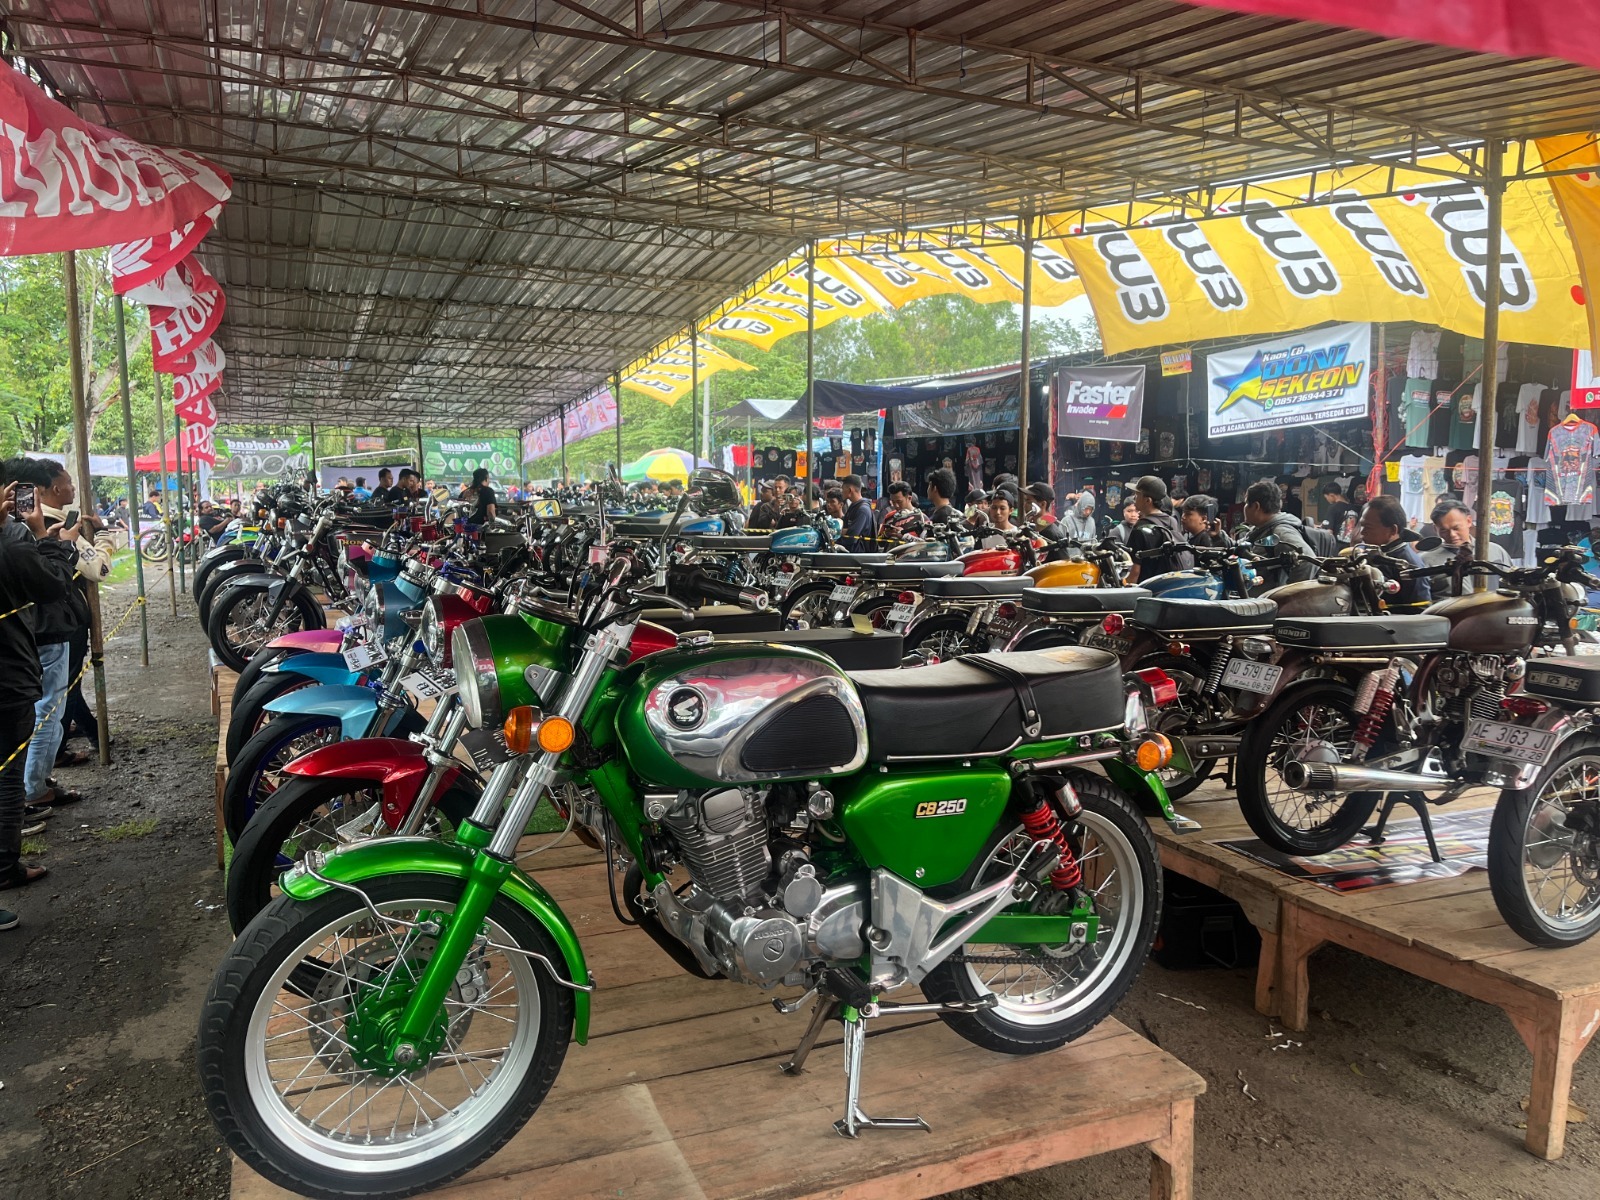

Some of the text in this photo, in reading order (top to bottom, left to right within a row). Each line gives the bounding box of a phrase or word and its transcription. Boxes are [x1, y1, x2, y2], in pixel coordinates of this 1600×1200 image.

[1262, 350, 1288, 363] Kaos
[1257, 362, 1364, 400] SEKEON
[1066, 381, 1136, 405] Faster
[1067, 404, 1098, 414] Invader
[1472, 723, 1492, 739] AE
[1496, 727, 1529, 746] 3163
[916, 798, 968, 816] CB250
